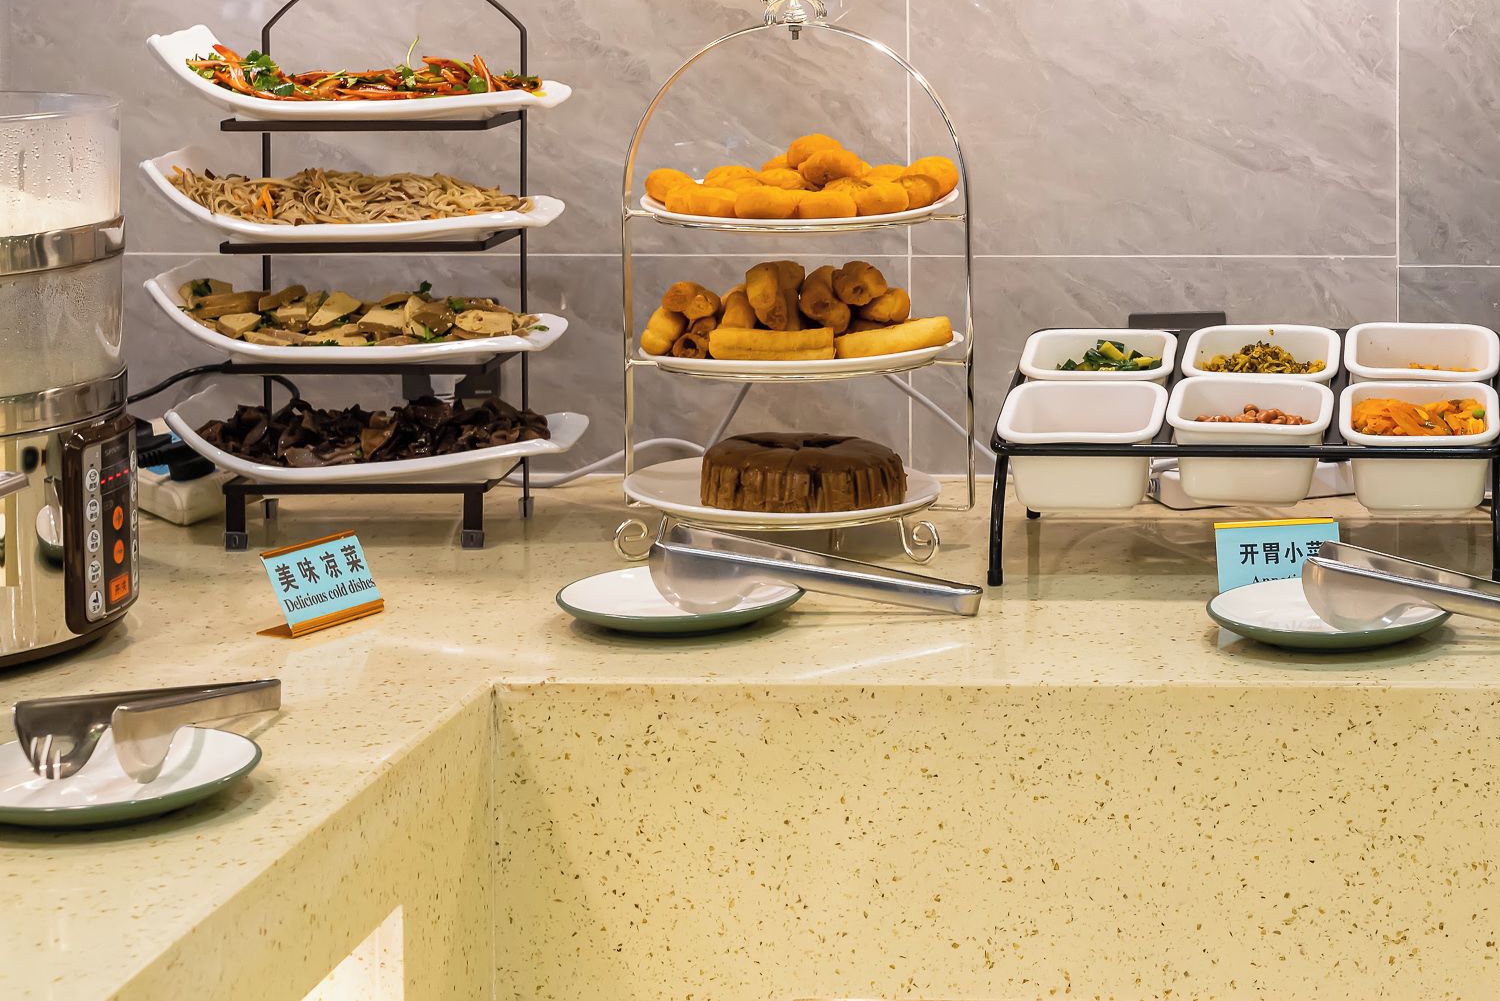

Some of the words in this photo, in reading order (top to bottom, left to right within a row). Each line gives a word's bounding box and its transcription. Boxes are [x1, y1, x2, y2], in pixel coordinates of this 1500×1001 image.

[275, 545, 365, 593] 美味凉菜
[284, 591, 328, 612] Delicious
[328, 582, 348, 599] cold
[348, 577, 376, 593] dishes
